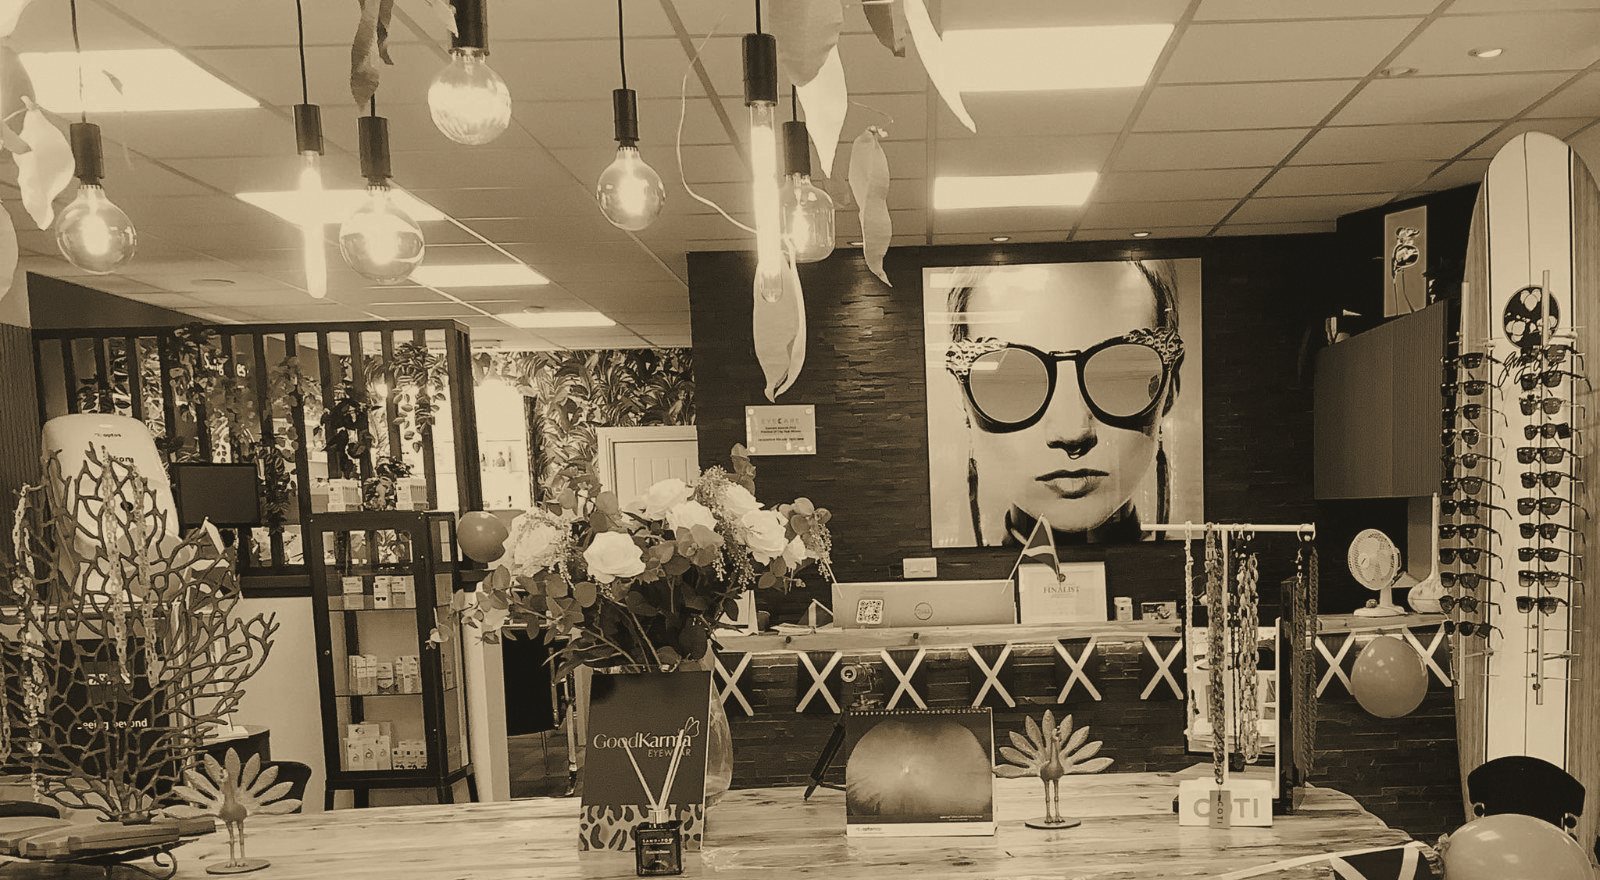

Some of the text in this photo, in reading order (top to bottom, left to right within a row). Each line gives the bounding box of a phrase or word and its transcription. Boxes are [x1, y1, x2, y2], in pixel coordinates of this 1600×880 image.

[77, 717, 148, 730] eeig eond
[648, 748, 692, 758] EYEWAR
[1193, 798, 1259, 818] CTI
